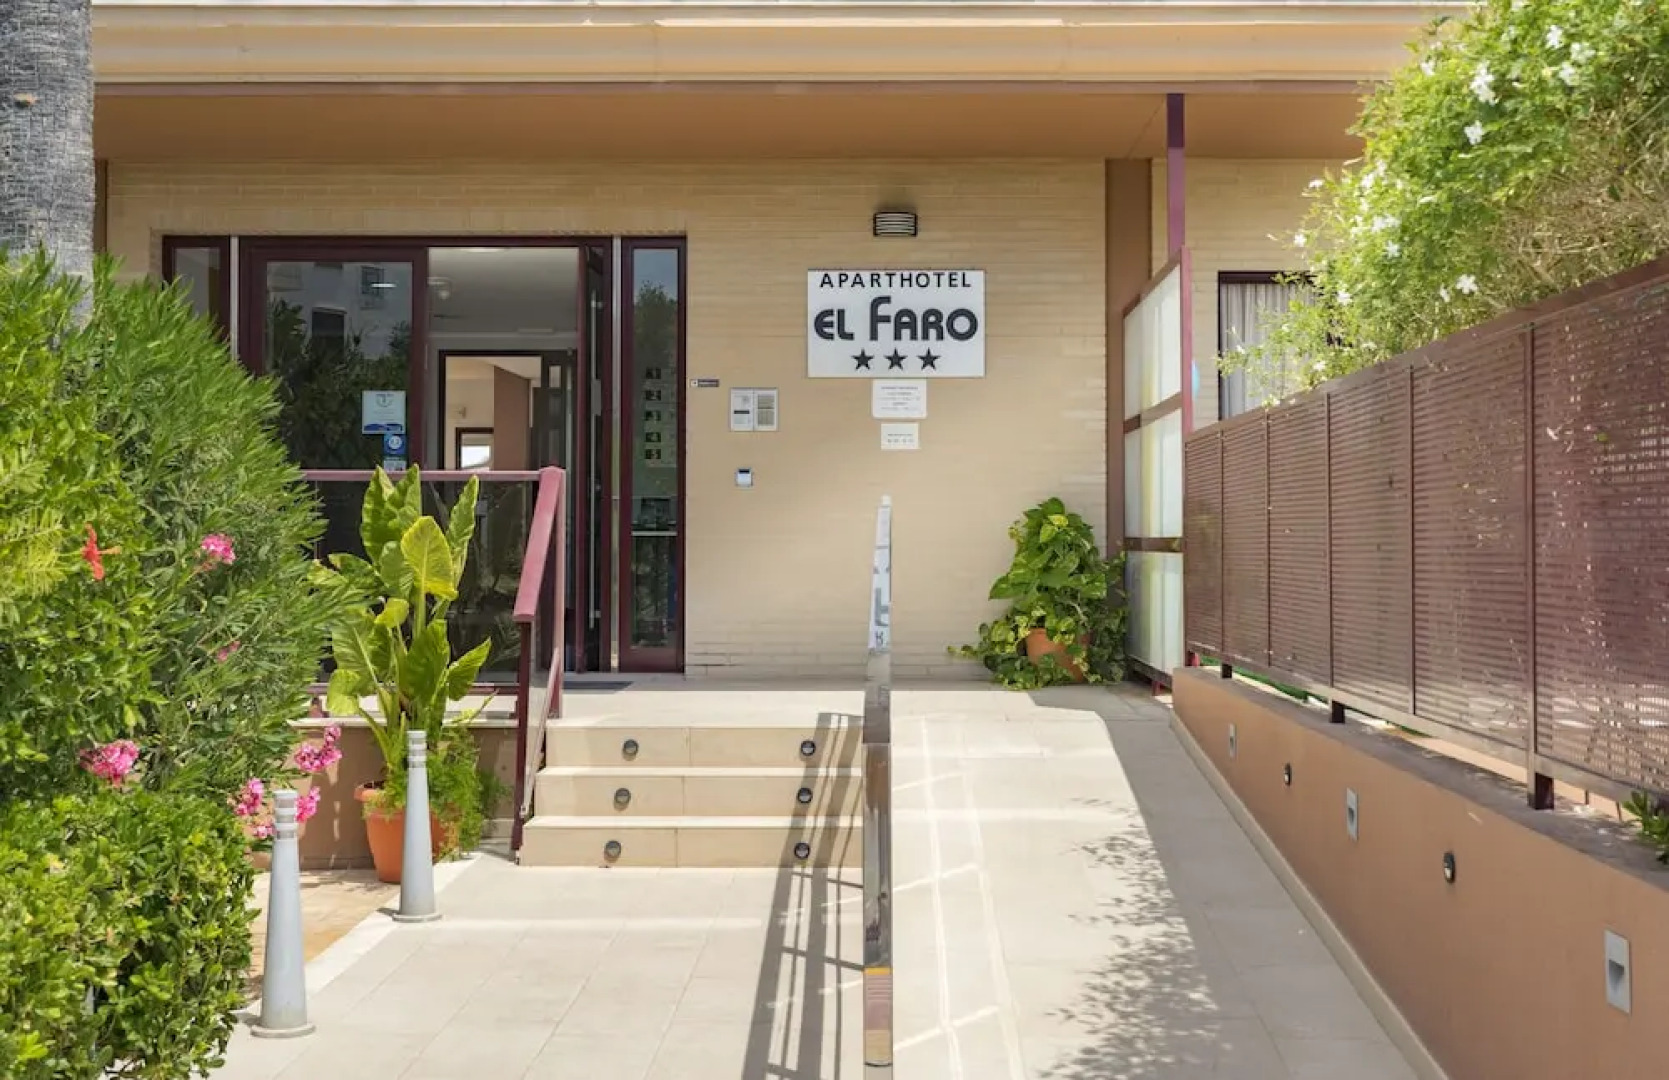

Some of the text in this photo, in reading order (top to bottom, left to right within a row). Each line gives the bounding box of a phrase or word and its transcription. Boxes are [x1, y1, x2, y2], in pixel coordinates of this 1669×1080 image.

[819, 272, 972, 288] APARTHOTEL
[814, 295, 979, 342] EL FARO
